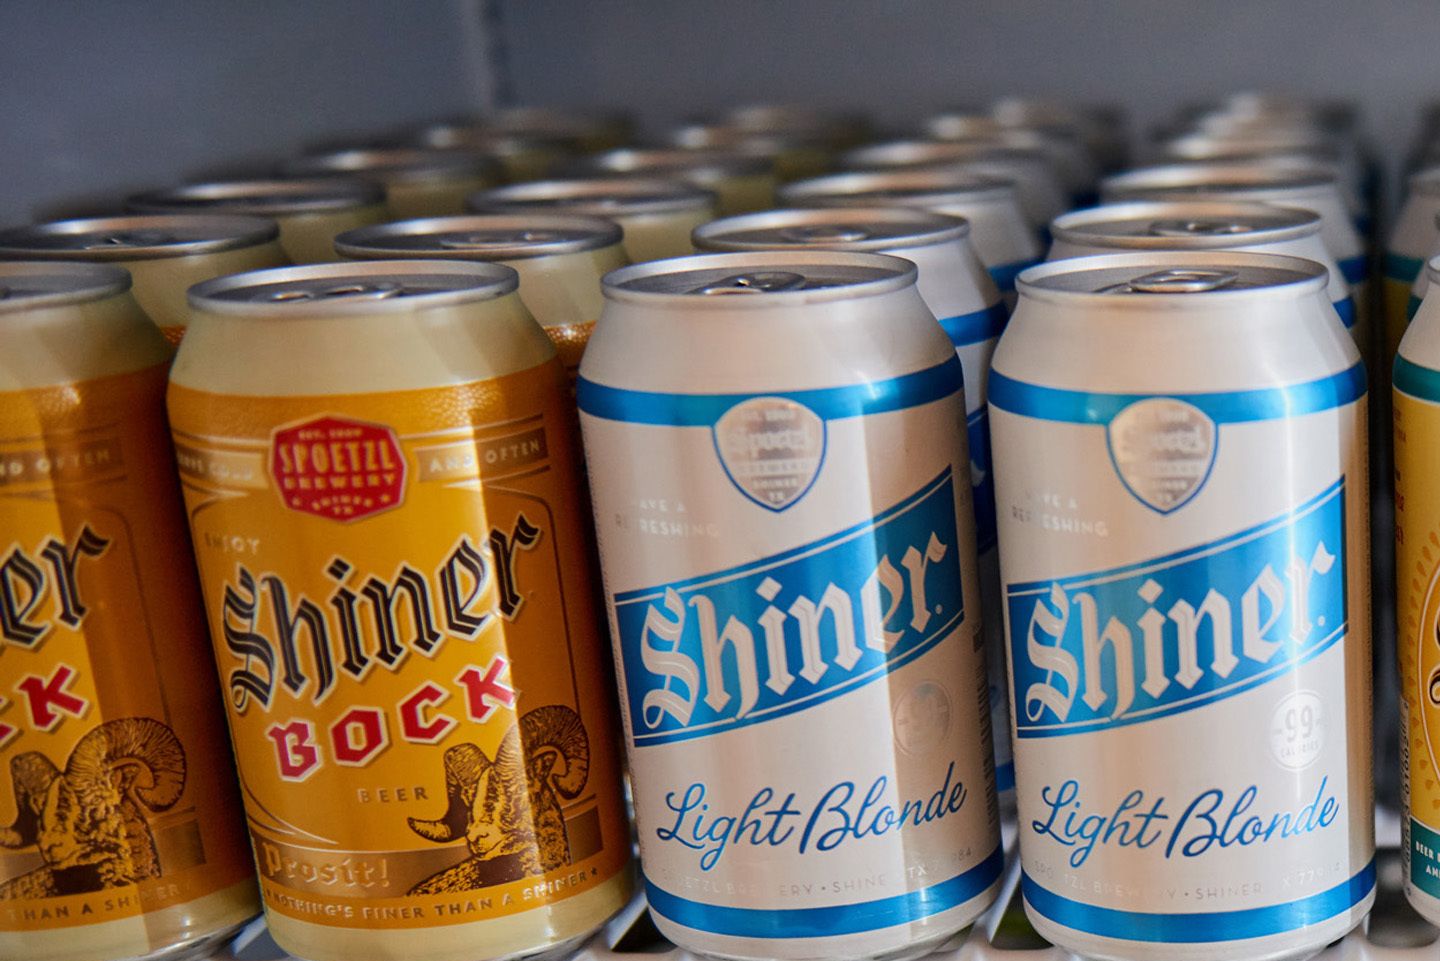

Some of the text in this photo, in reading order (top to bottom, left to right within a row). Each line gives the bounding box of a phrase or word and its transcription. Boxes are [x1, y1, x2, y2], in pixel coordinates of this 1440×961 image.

[279, 439, 395, 474] SPOETZL
[485, 439, 540, 464] OFTEN
[222, 514, 540, 714] Shiner
[640, 531, 948, 728] Shiner
[1027, 541, 1336, 722] Shiner
[268, 656, 518, 783] BOCK
[358, 784, 430, 805] BEER
[655, 760, 969, 872] Light Blonde
[1032, 774, 1340, 868] Light Blonde
[1416, 841, 1435, 861] BEER
[362, 905, 424, 920] FINER
[434, 897, 493, 917] THAN
[502, 893, 514, 906] A
